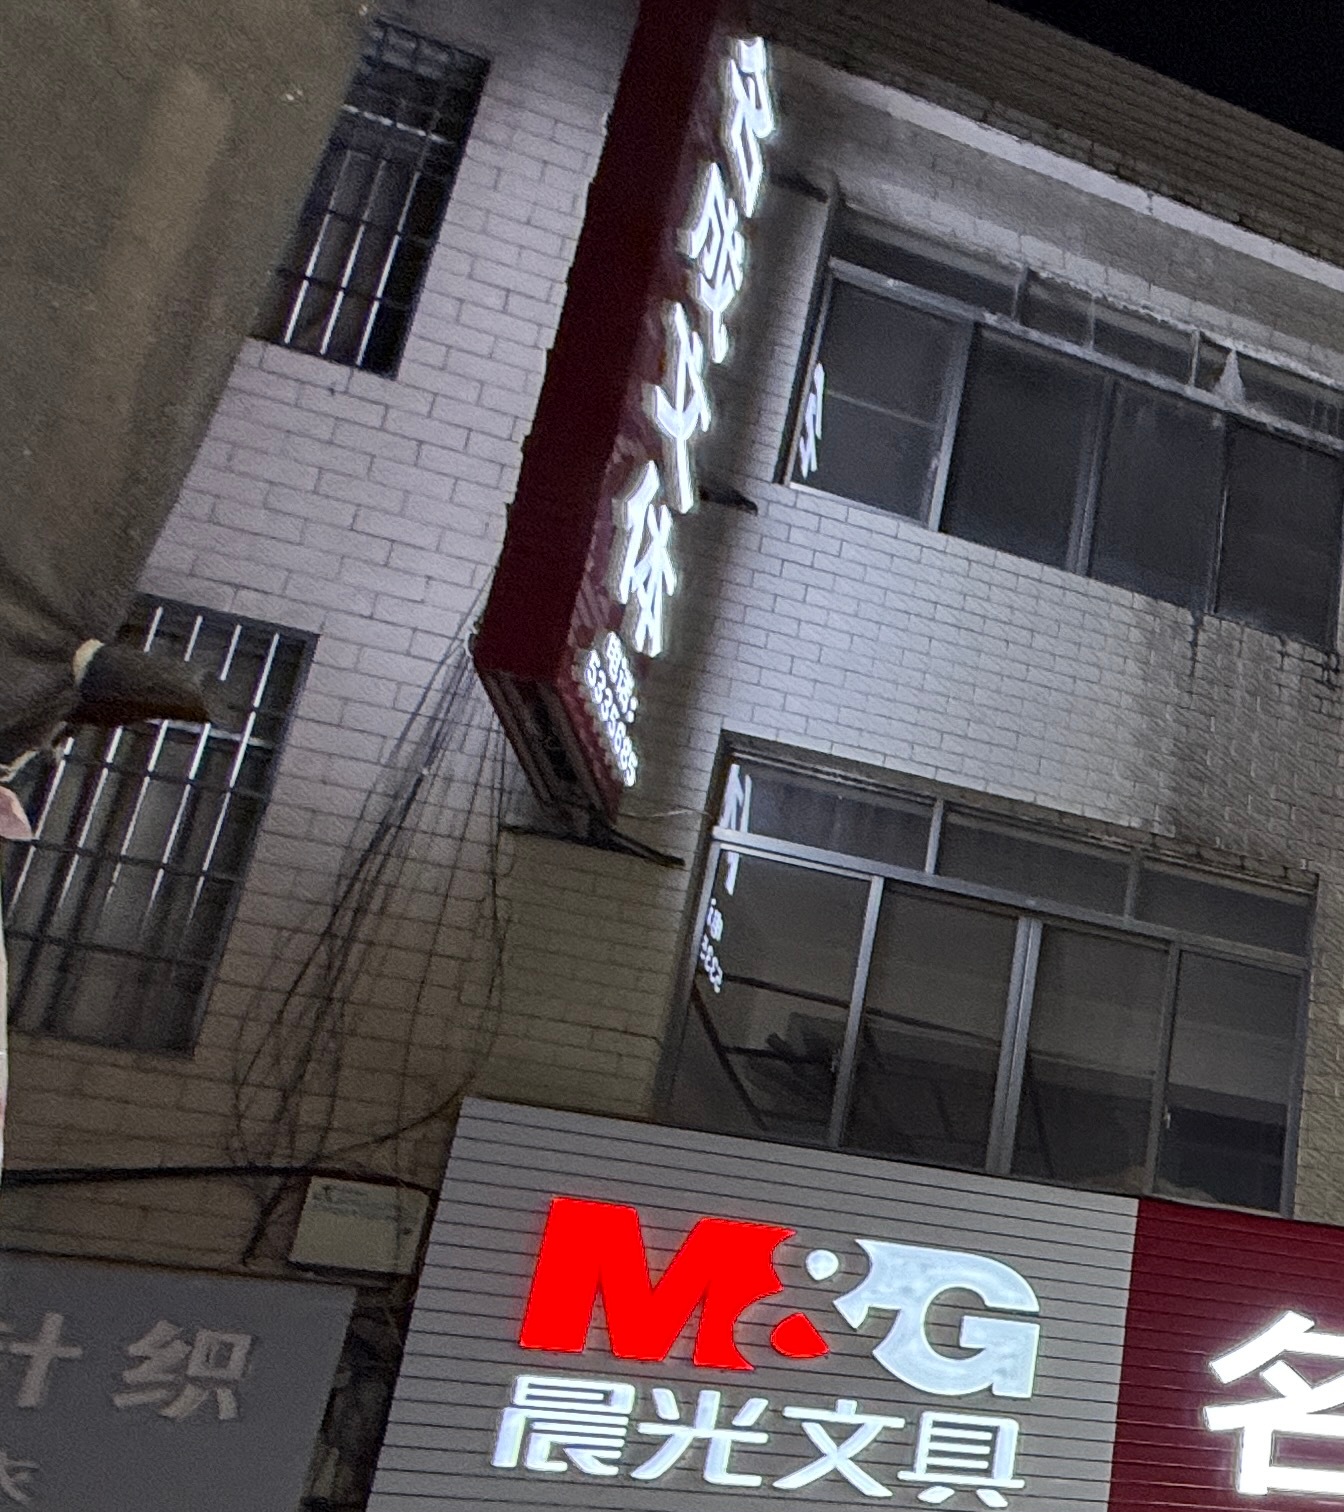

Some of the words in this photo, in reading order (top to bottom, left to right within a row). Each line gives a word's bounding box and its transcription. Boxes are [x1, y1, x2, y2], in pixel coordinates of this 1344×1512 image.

[518, 1195, 1040, 1399] M&G
[492, 1373, 1026, 1510] 晨光文具
